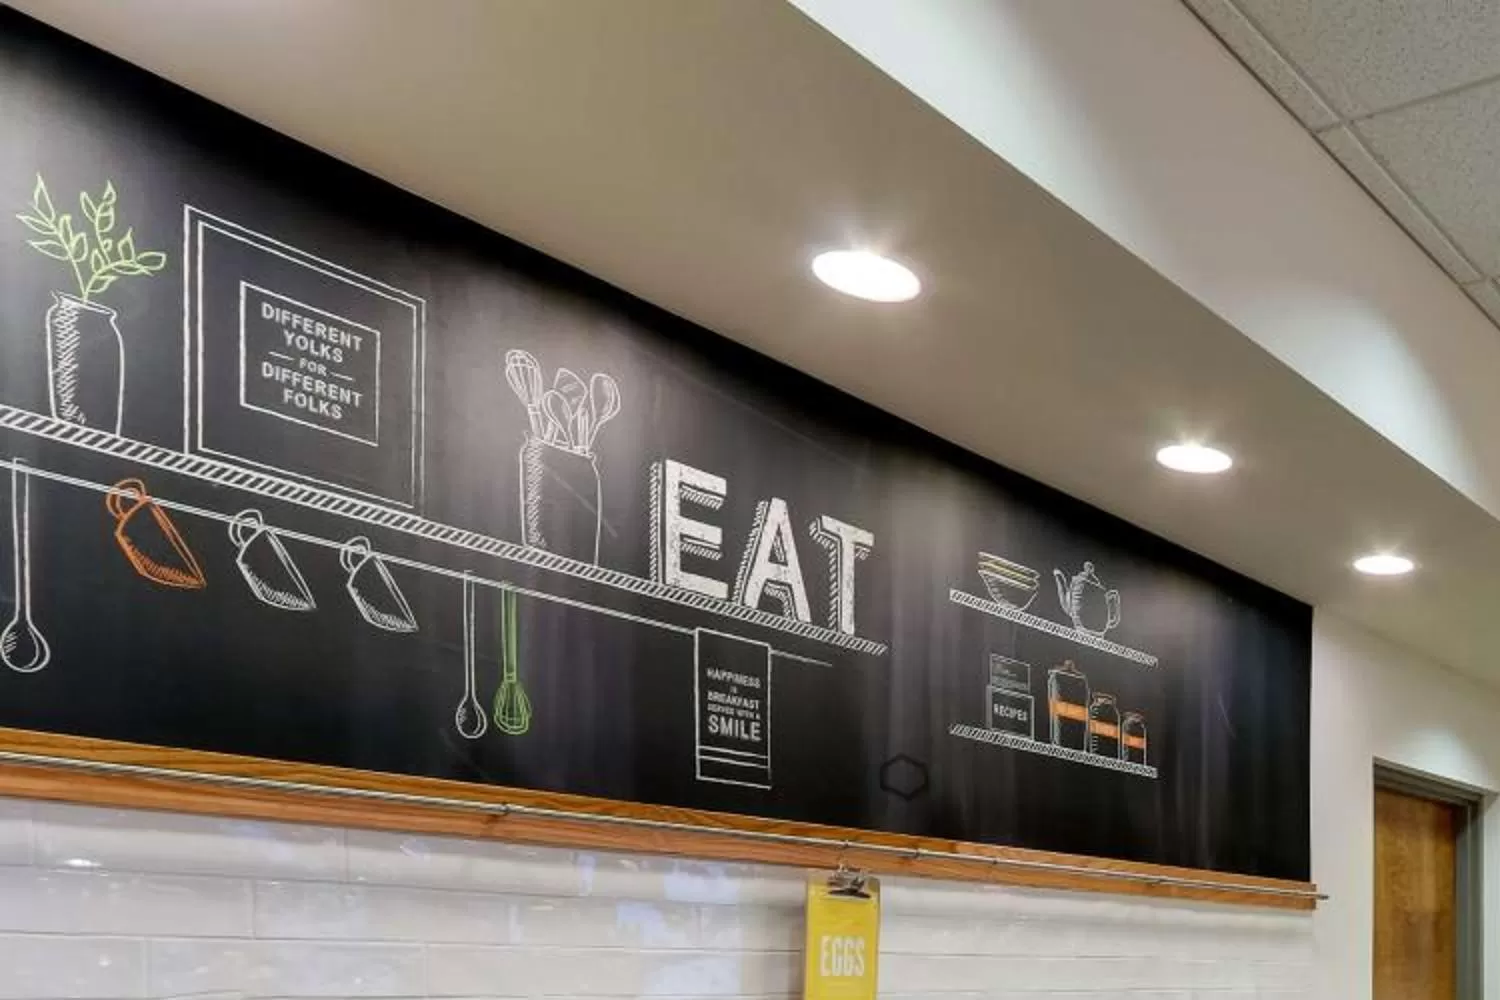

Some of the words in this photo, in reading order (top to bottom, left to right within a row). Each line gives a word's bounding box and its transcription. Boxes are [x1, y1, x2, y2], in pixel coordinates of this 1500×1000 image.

[261, 302, 362, 351] DIFFERENT
[283, 329, 343, 363] YOLKS
[300, 358, 327, 377] FOR
[261, 361, 362, 408] DIFFERENT
[283, 387, 342, 419] FOLKS
[650, 459, 875, 636] EAT
[706, 667, 761, 689] HAPPINESS
[707, 690, 760, 710] BREAKFAST
[993, 703, 1028, 721] RECIPES
[707, 713, 762, 741] SMILE
[820, 935, 865, 977] EGGS
